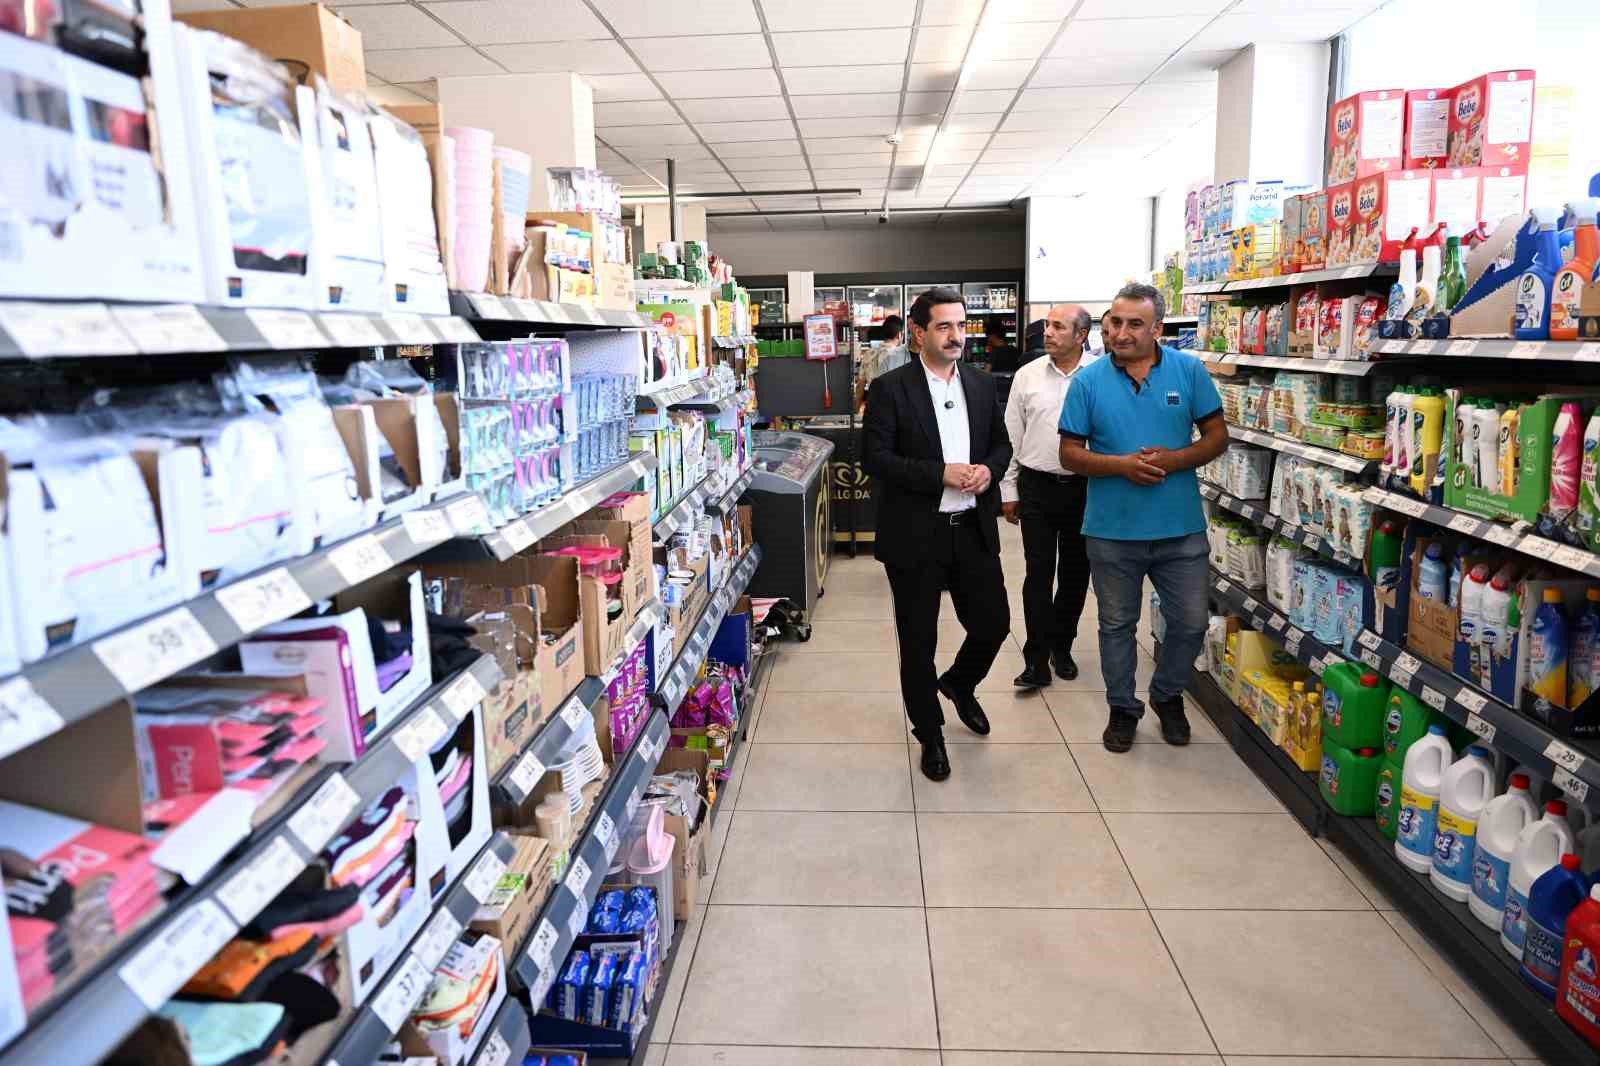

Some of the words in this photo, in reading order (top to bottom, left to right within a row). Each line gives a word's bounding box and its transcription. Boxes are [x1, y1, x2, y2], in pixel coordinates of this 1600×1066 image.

[1458, 101, 1476, 117] Bebe
[1334, 203, 1349, 217] Bebe
[1359, 195, 1376, 210] Bebe
[1454, 470, 1465, 487] Cif
[832, 489, 872, 500] LGDA
